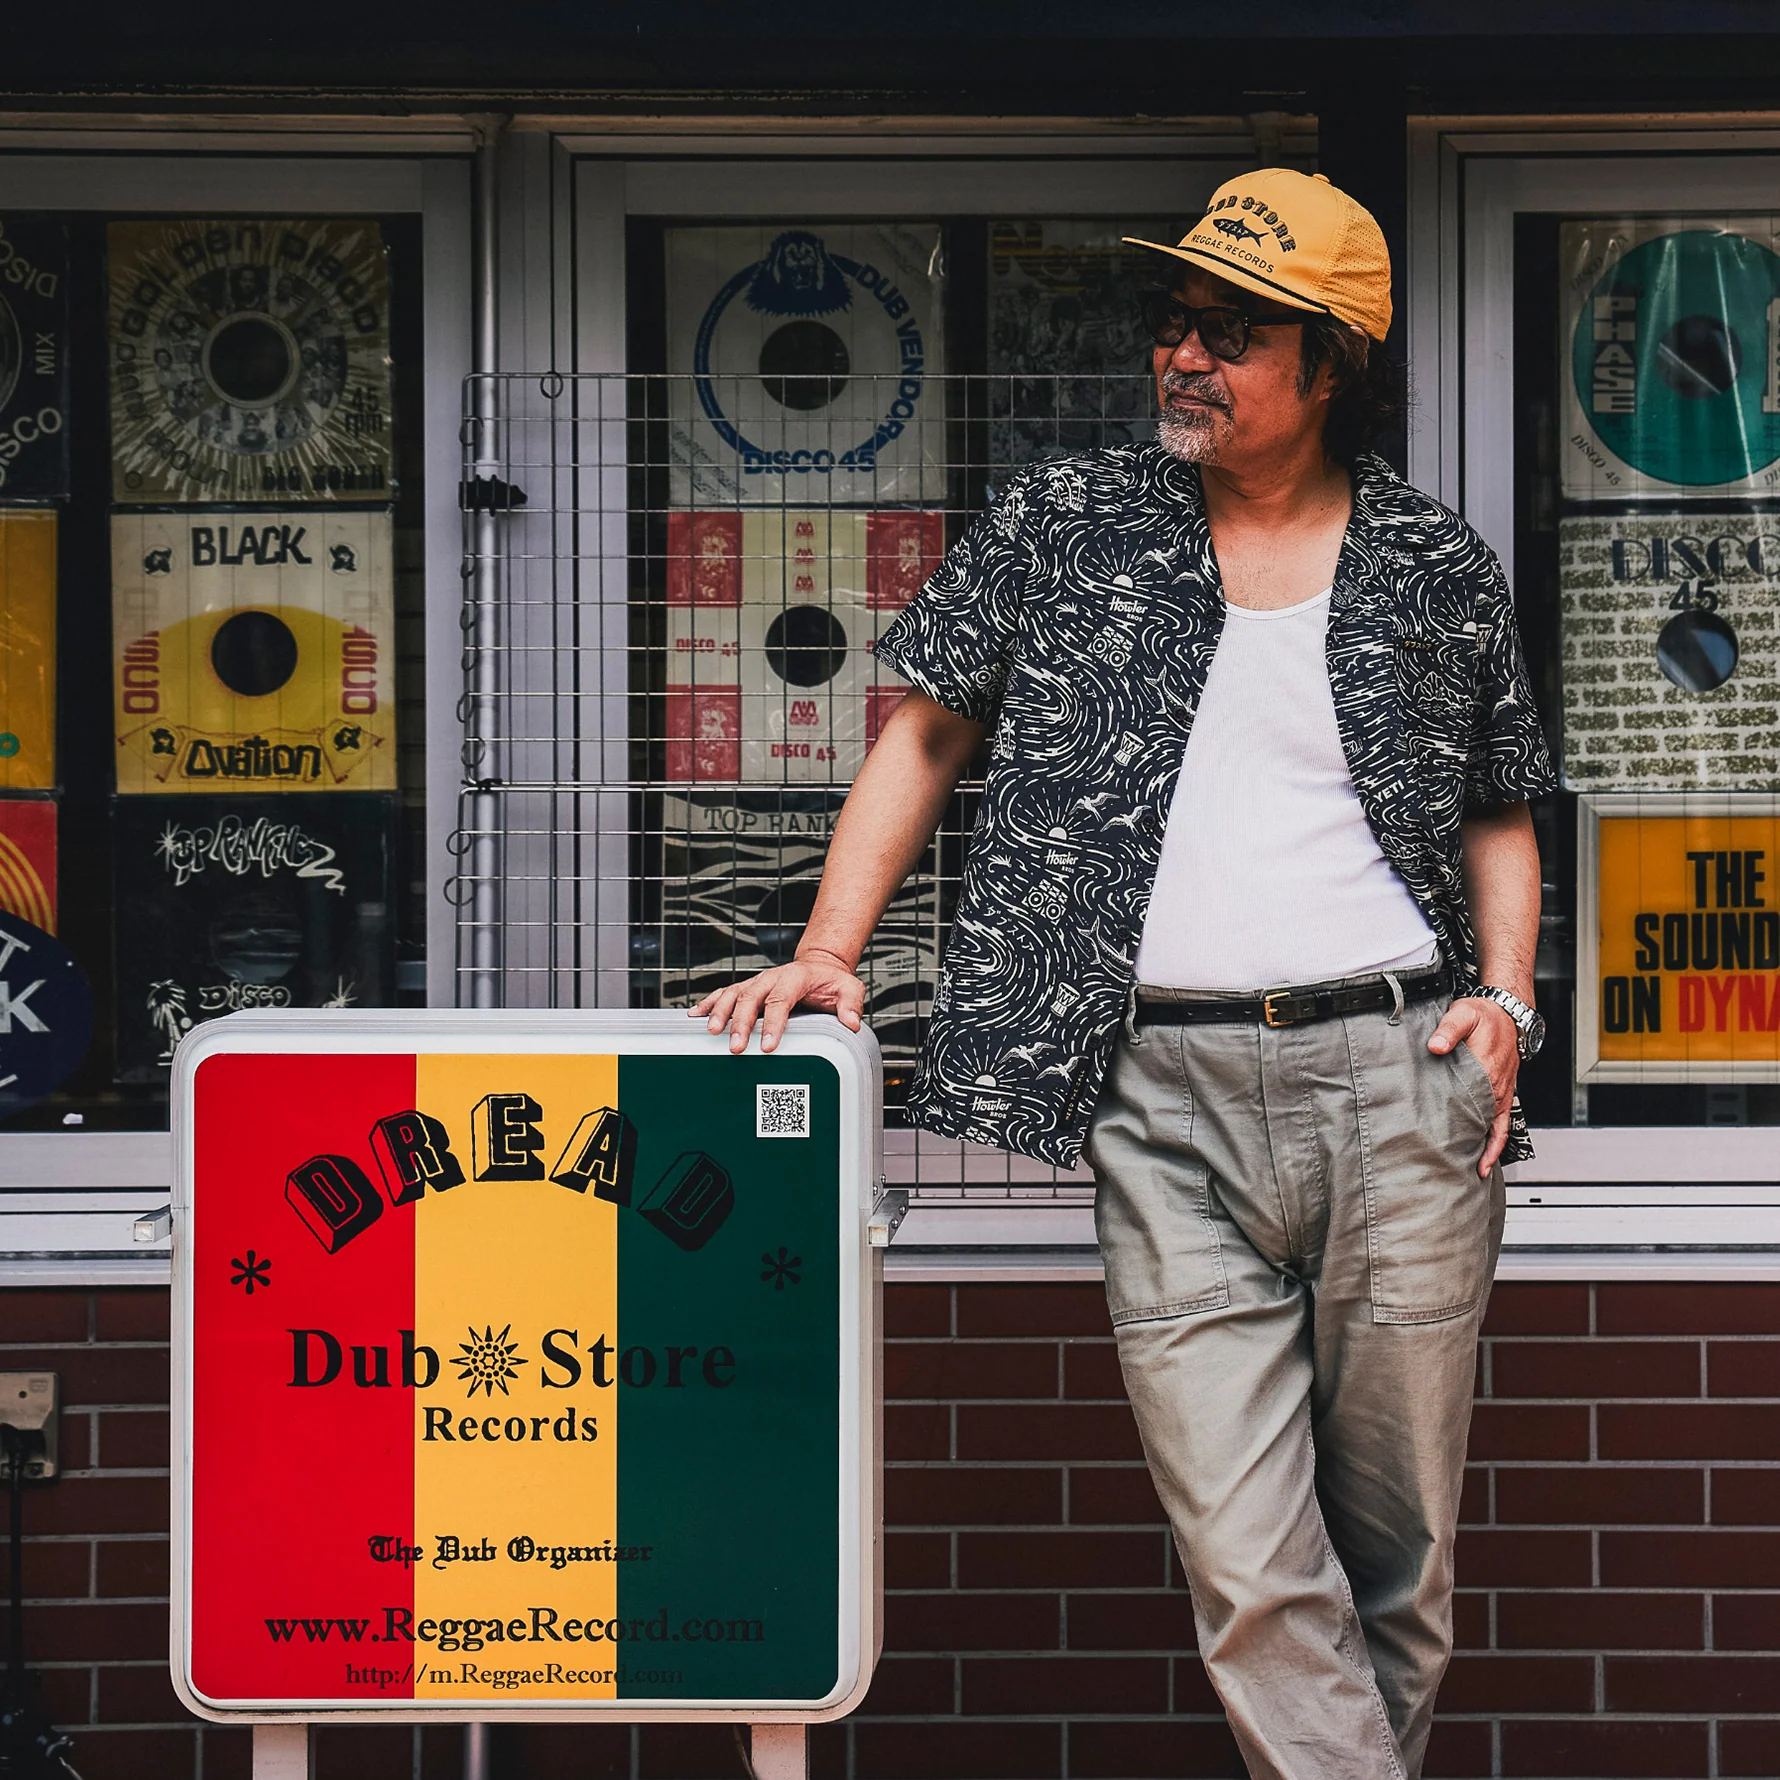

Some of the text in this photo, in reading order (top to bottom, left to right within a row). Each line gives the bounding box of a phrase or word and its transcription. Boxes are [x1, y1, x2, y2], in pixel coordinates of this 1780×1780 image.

[1241, 197, 1297, 253] STORE
[1191, 234, 1275, 273] REGGAE RECORDS
[856, 262, 910, 320] DUB
[36, 332, 55, 375] MIX
[878, 318, 925, 440] VENDOR
[743, 449, 876, 474] DISCO 45
[1570, 434, 1607, 470] DISCO
[191, 525, 312, 566] BLACK
[1612, 534, 1780, 581] DISCO
[1107, 595, 1149, 614] Howler
[1669, 581, 1719, 613] 45
[676, 638, 715, 652] DISCO
[771, 744, 837, 762] DISCO 45
[1373, 780, 1405, 803] YETI
[703, 808, 840, 835] TOP RANK
[1044, 848, 1079, 865] Howler
[1686, 851, 1765, 908] THE
[1635, 912, 1780, 971] SOUND
[1604, 976, 1662, 1034] ON
[969, 1095, 1013, 1112] Howler
[284, 1093, 735, 1255] DREAD
[286, 1328, 737, 1389] Dub Store
[422, 1407, 598, 1442] Records
[367, 1535, 654, 1570] The Dub Organizer
[264, 1607, 766, 1652] www.ReggaeRecord.com
[345, 1663, 684, 1690] http://m.ReggaeRecord.com
